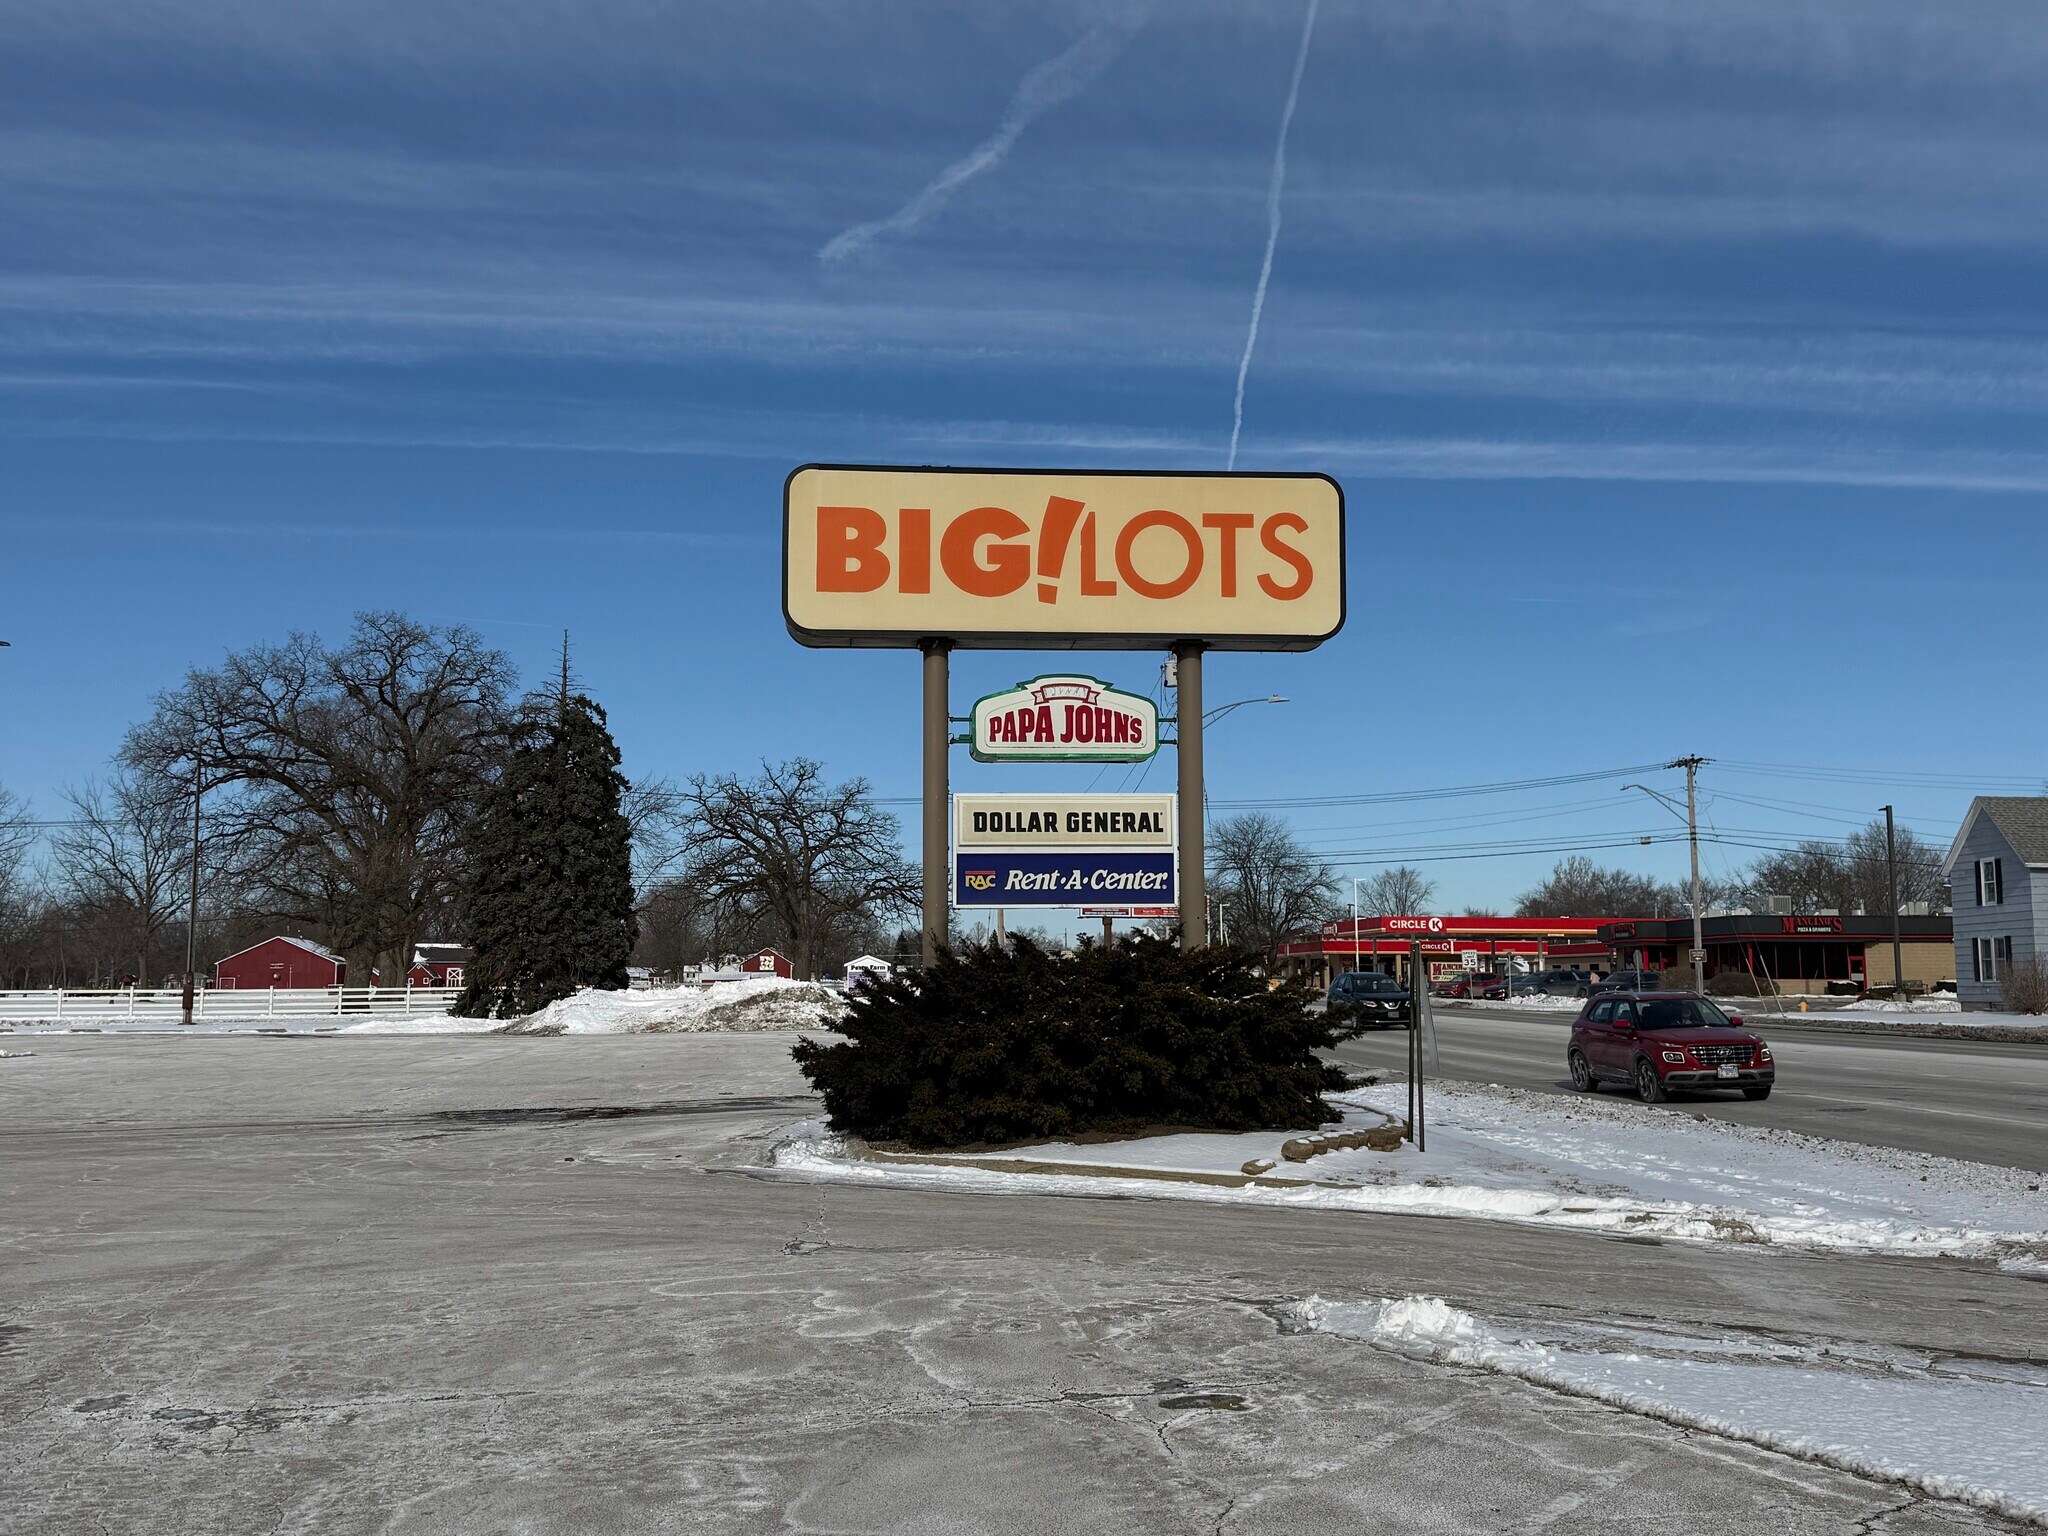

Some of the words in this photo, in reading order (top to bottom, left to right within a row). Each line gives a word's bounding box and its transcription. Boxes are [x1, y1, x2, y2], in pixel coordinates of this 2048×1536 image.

[1080, 510, 1314, 601] LOTS
[989, 704, 1055, 744] PAPA
[1060, 704, 1143, 744] JOHN'S
[972, 811, 1059, 833] DOLLAR
[1066, 811, 1163, 833] GENERAL
[965, 873, 996, 891] RAC
[1389, 919, 1427, 929] CIRCLE
[1464, 958, 1477, 967] 35
